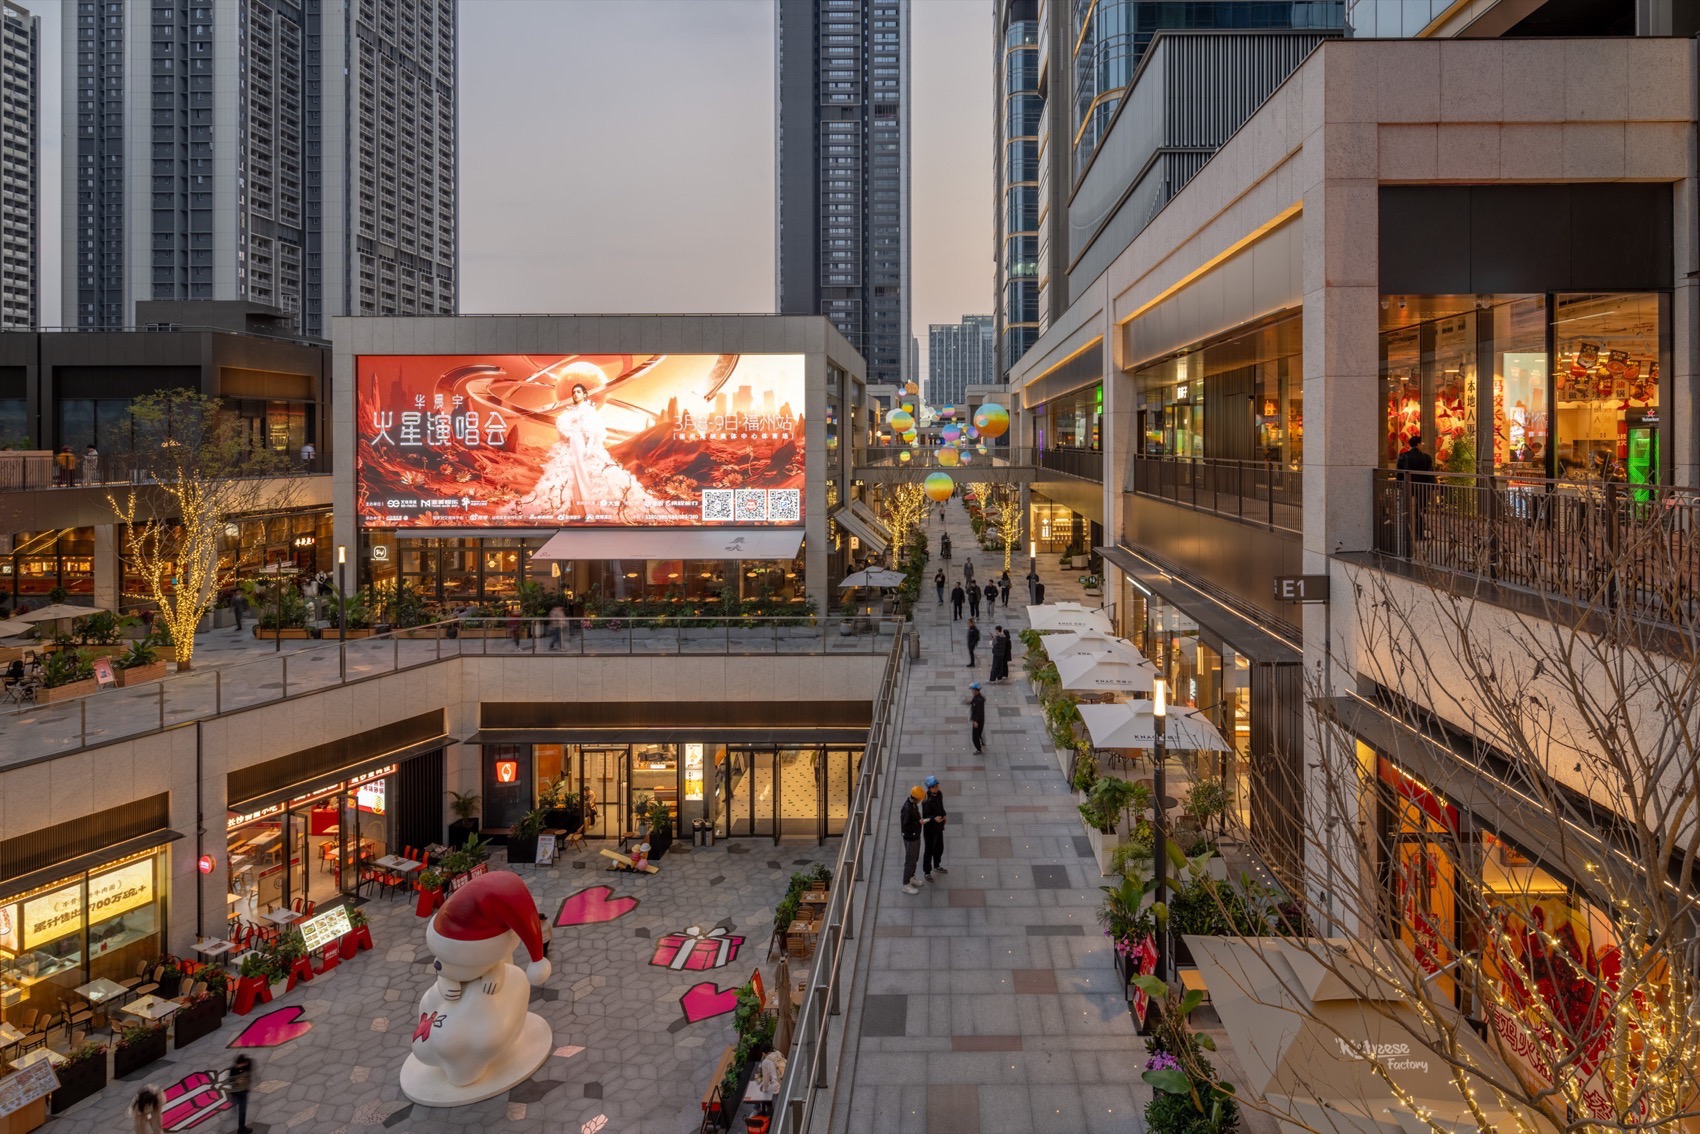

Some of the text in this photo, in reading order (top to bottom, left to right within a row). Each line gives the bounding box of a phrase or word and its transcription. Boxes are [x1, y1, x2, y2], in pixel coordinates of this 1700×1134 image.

[414, 393, 464, 409] 华晨宇
[371, 411, 508, 446] 火星演唱会
[1282, 580, 1305, 597] E1
[33, 884, 147, 934] 累计售出700万碗+
[1387, 1058, 1429, 1073] Factory
